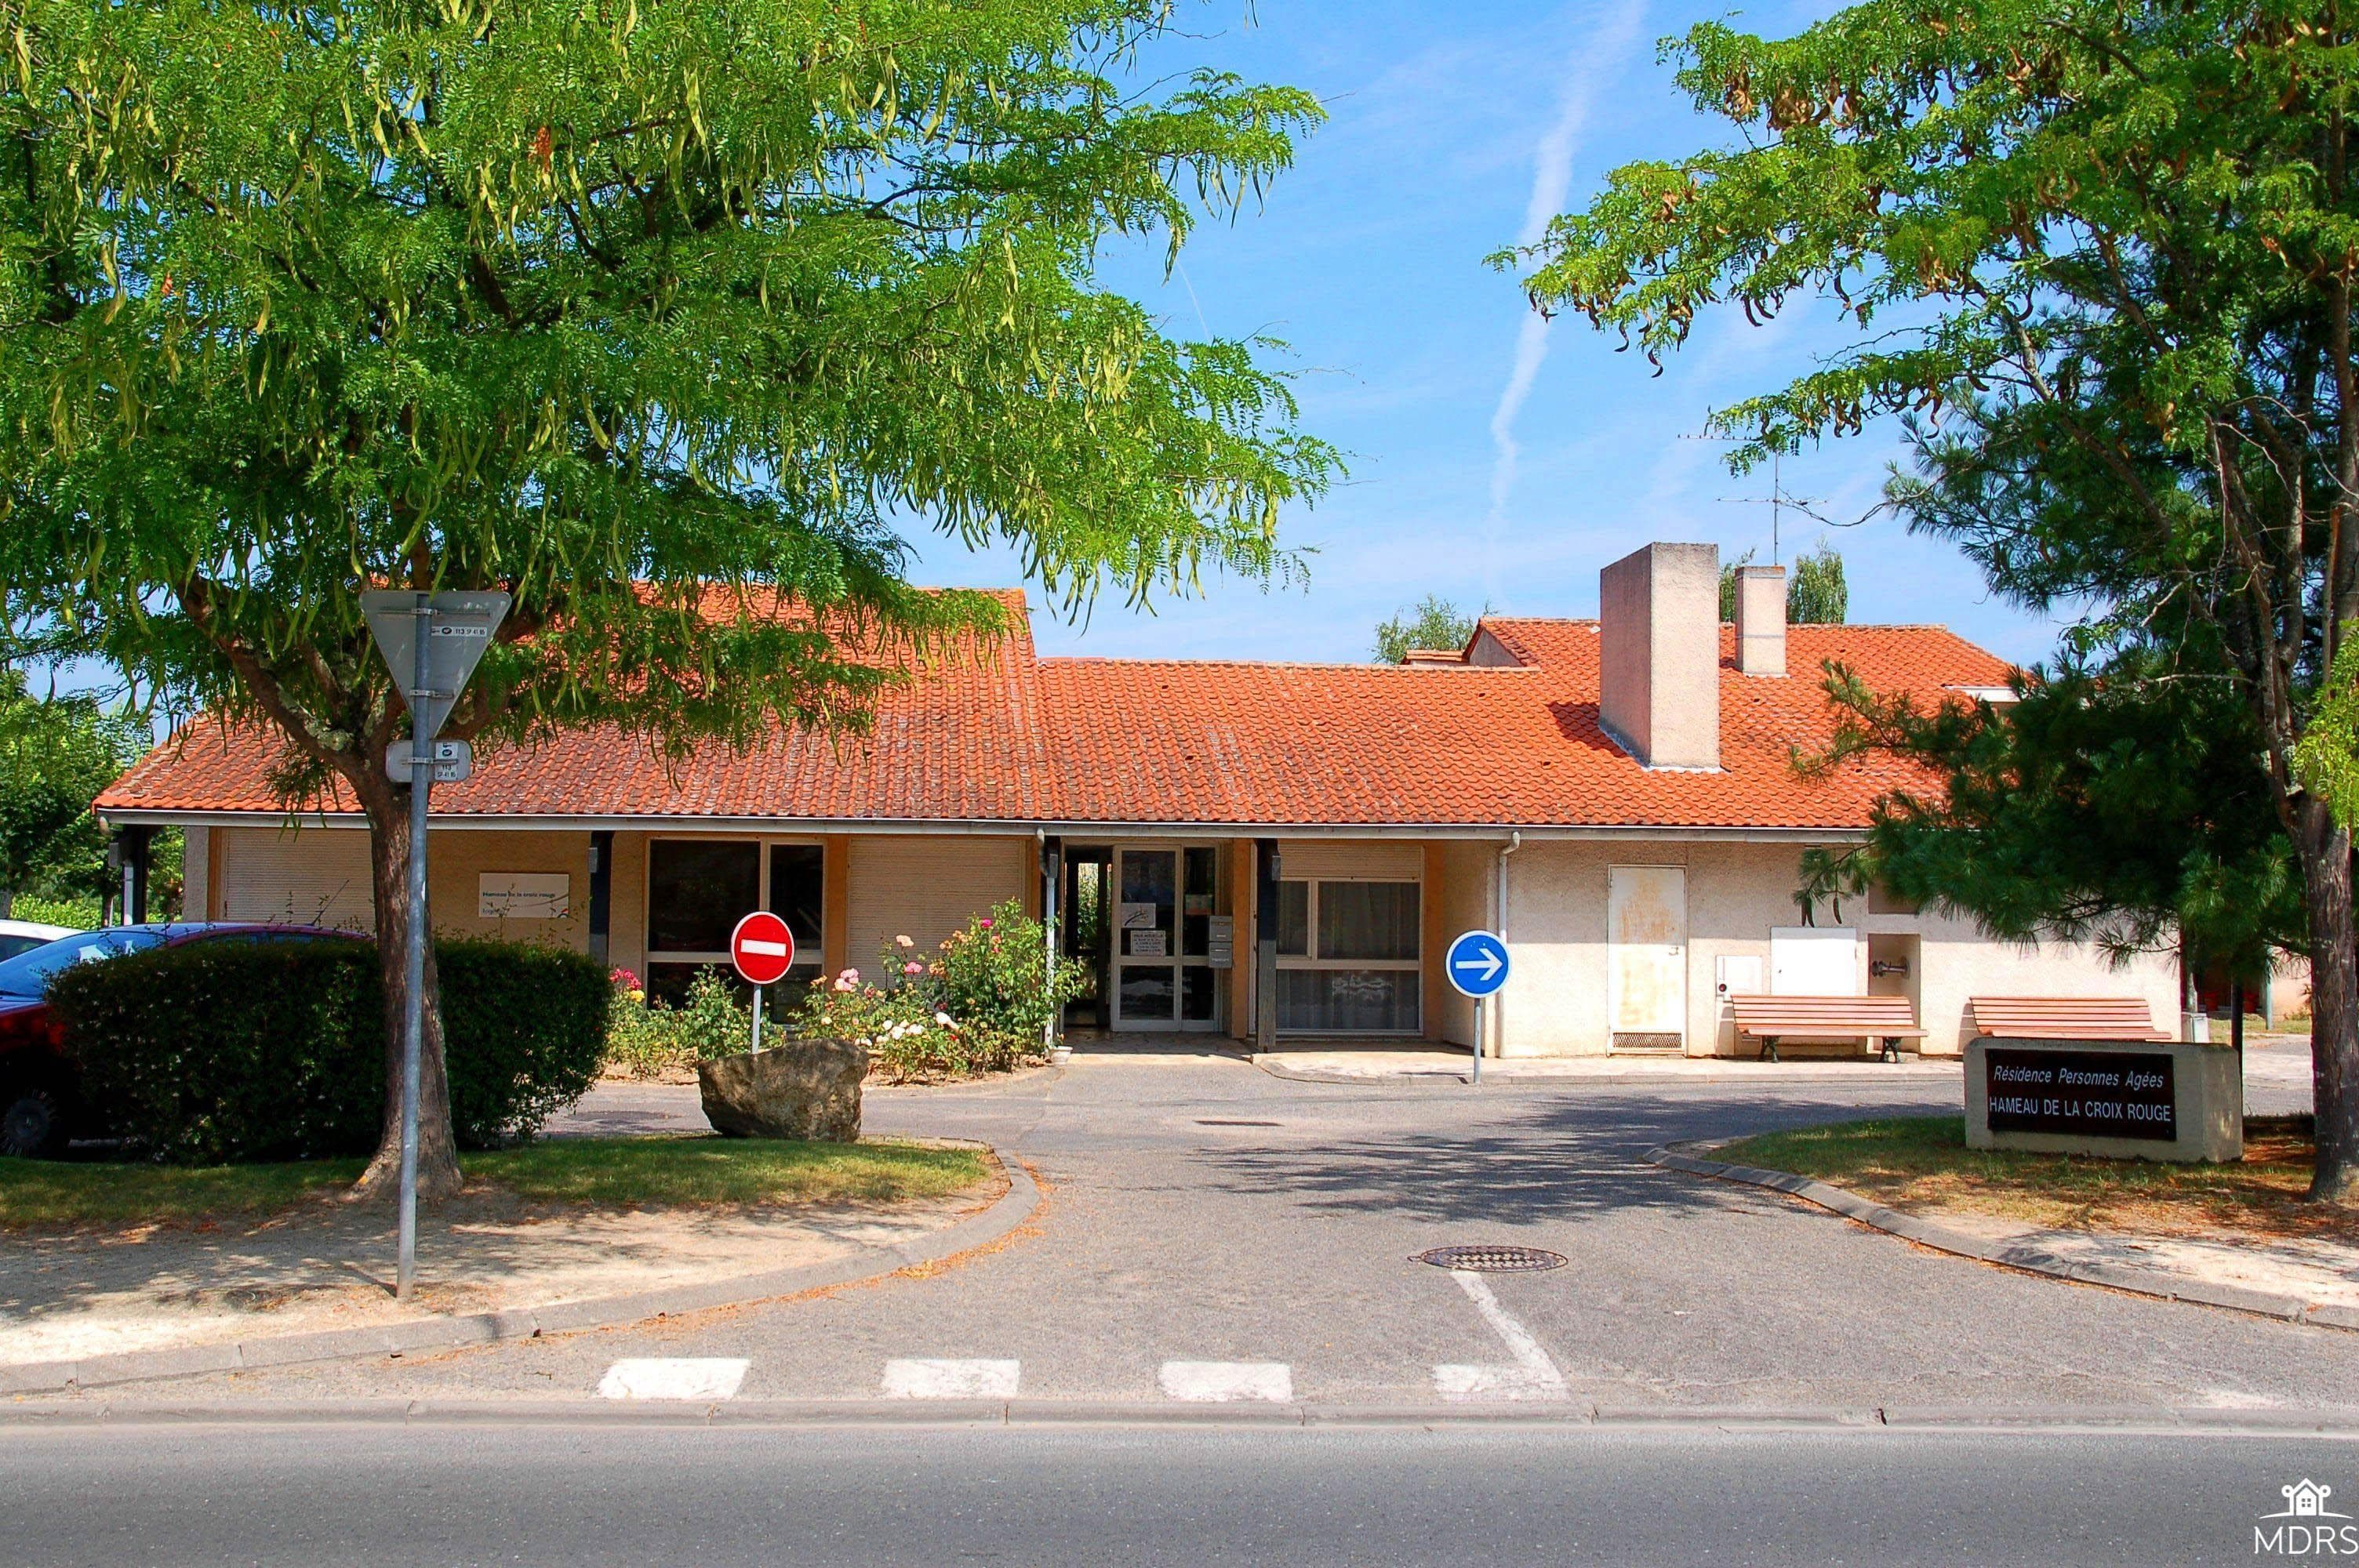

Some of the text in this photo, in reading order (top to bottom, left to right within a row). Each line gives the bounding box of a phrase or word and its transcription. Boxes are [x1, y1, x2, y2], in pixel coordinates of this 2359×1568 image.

[1994, 1065, 2164, 1091] Résidence Personnes Agées
[1989, 1096, 2172, 1121] HAMEAU DE LA CROIX ROUGE
